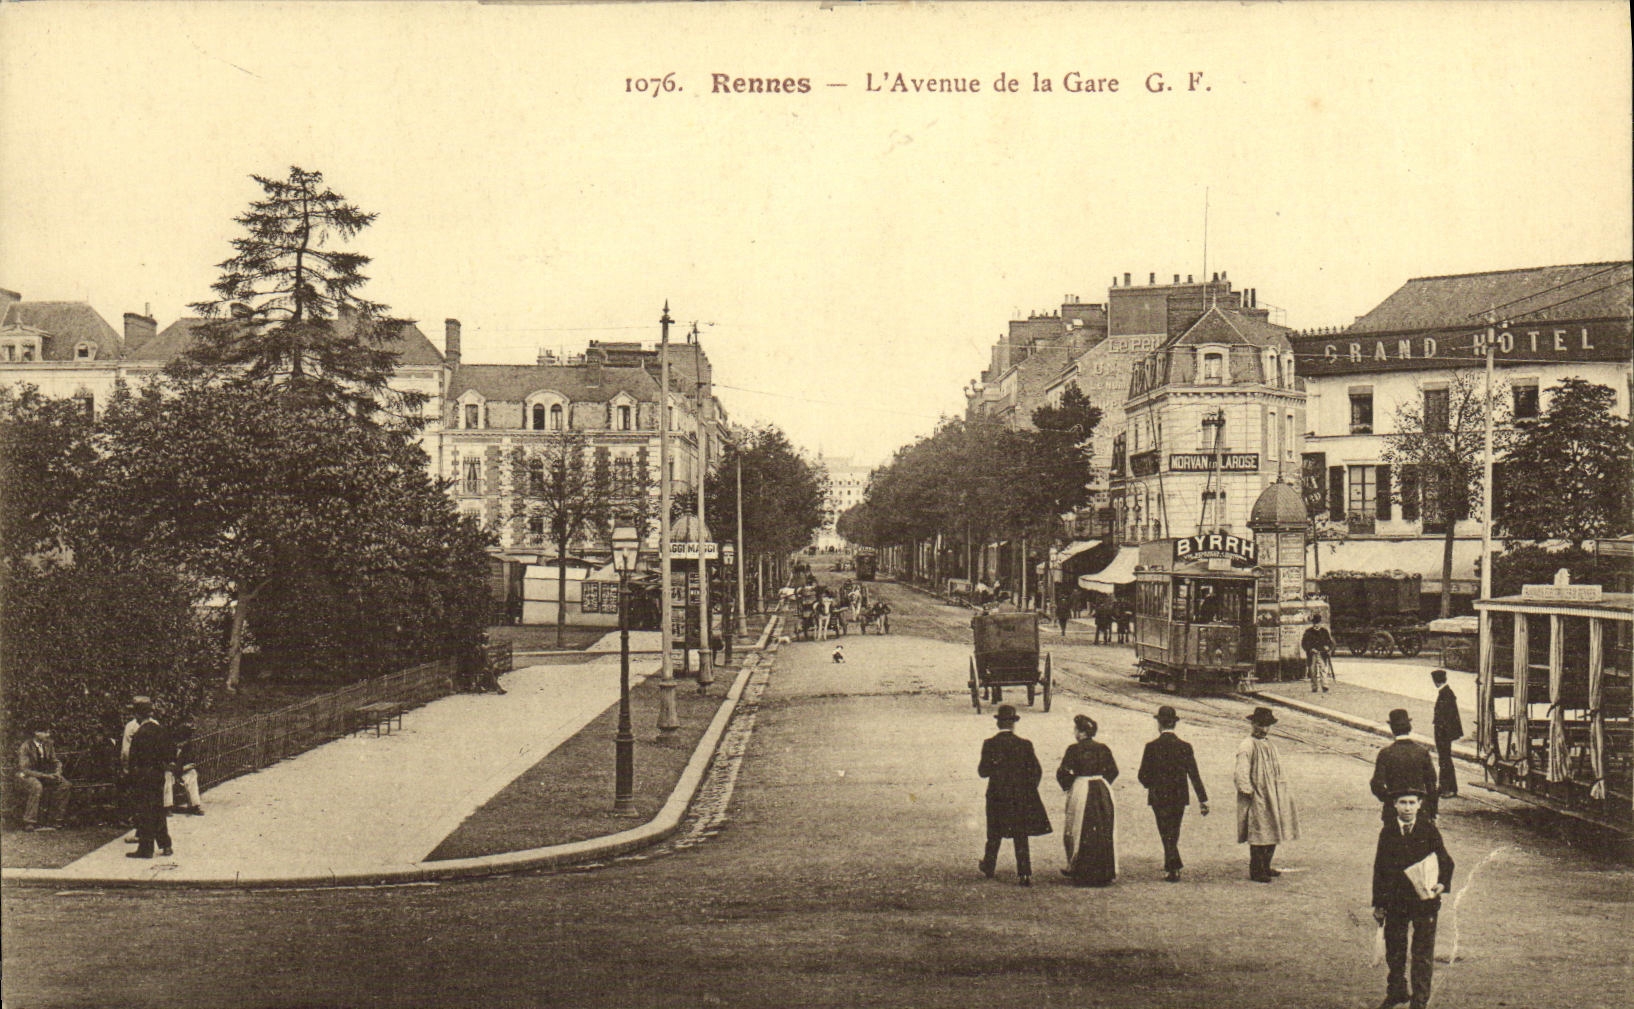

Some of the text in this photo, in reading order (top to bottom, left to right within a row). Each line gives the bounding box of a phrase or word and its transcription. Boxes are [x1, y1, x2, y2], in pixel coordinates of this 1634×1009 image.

[1324, 328, 1595, 365] GRAND HOTEL
[1171, 455, 1208, 469] MORVAN
[1220, 455, 1257, 468] LAROSE
[1177, 534, 1255, 559] BYRRH
